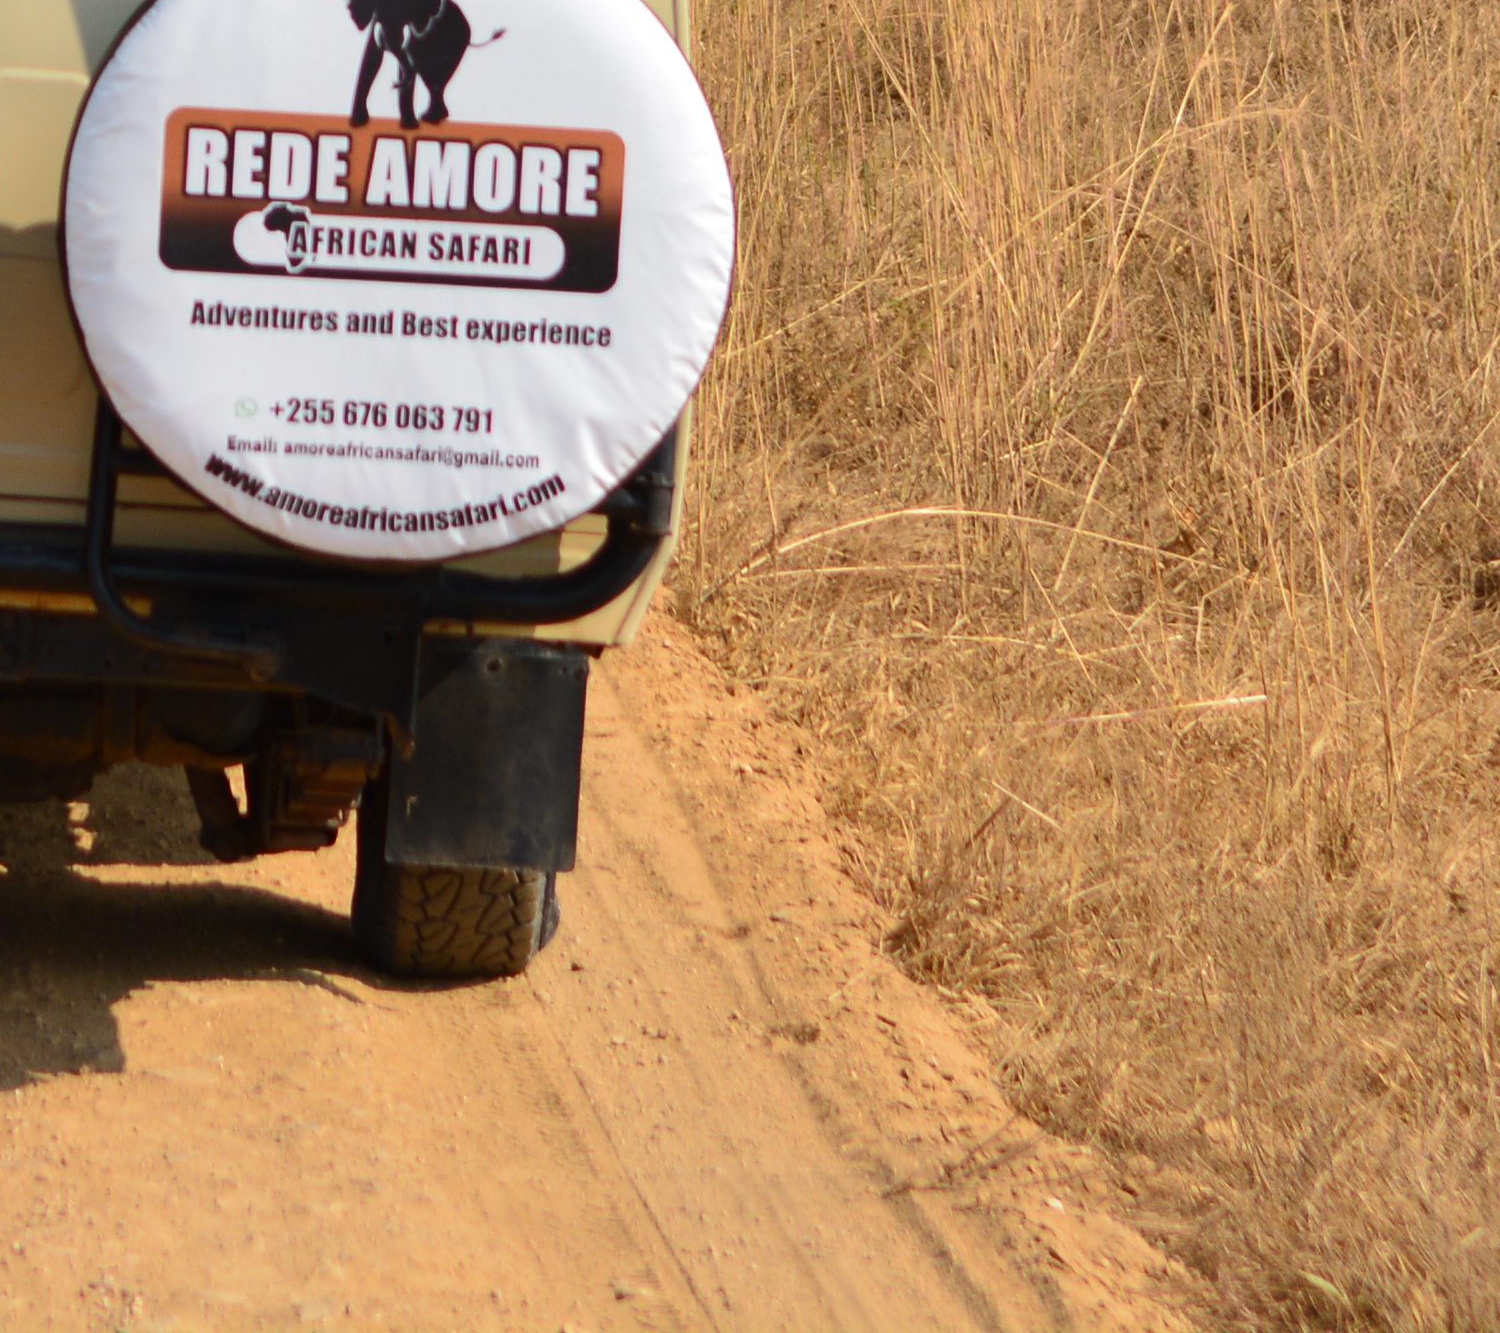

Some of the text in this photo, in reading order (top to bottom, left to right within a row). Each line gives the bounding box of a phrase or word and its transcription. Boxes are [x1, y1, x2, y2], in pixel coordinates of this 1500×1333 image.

[185, 126, 601, 217] REDE AMORE
[289, 224, 532, 266] AFRICAN SAFARI
[191, 299, 612, 347] Adventures and Best experience
[269, 397, 494, 434] +255 676 063 791
[226, 435, 540, 469] Email: amoreafricansafari@gmail.com
[204, 453, 566, 533] www.amoreafricansafari.com
